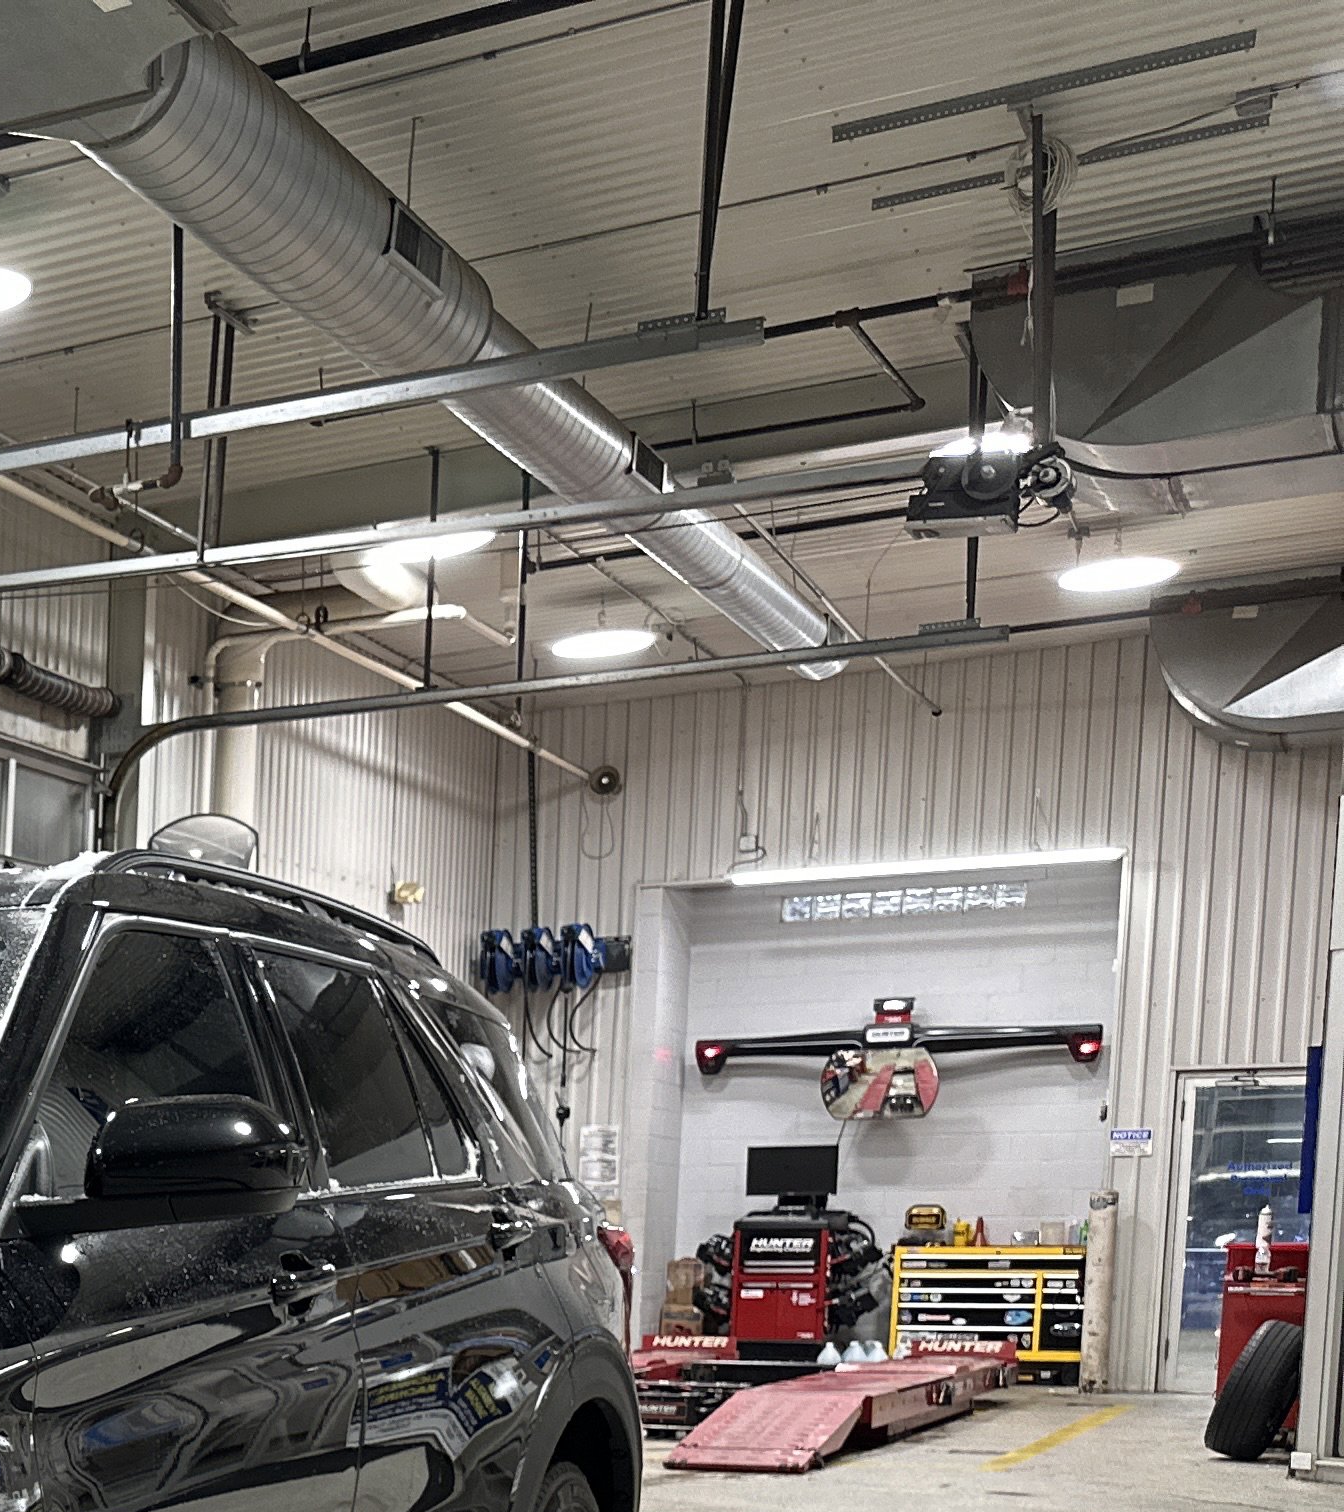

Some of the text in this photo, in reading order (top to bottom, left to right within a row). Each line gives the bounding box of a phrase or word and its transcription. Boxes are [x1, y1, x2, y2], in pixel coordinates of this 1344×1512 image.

[1112, 1131, 1149, 1140] NOTICE
[751, 1237, 814, 1249] HUNTER
[652, 1335, 730, 1348] HUNTER
[918, 1340, 1003, 1354] HUNTER
